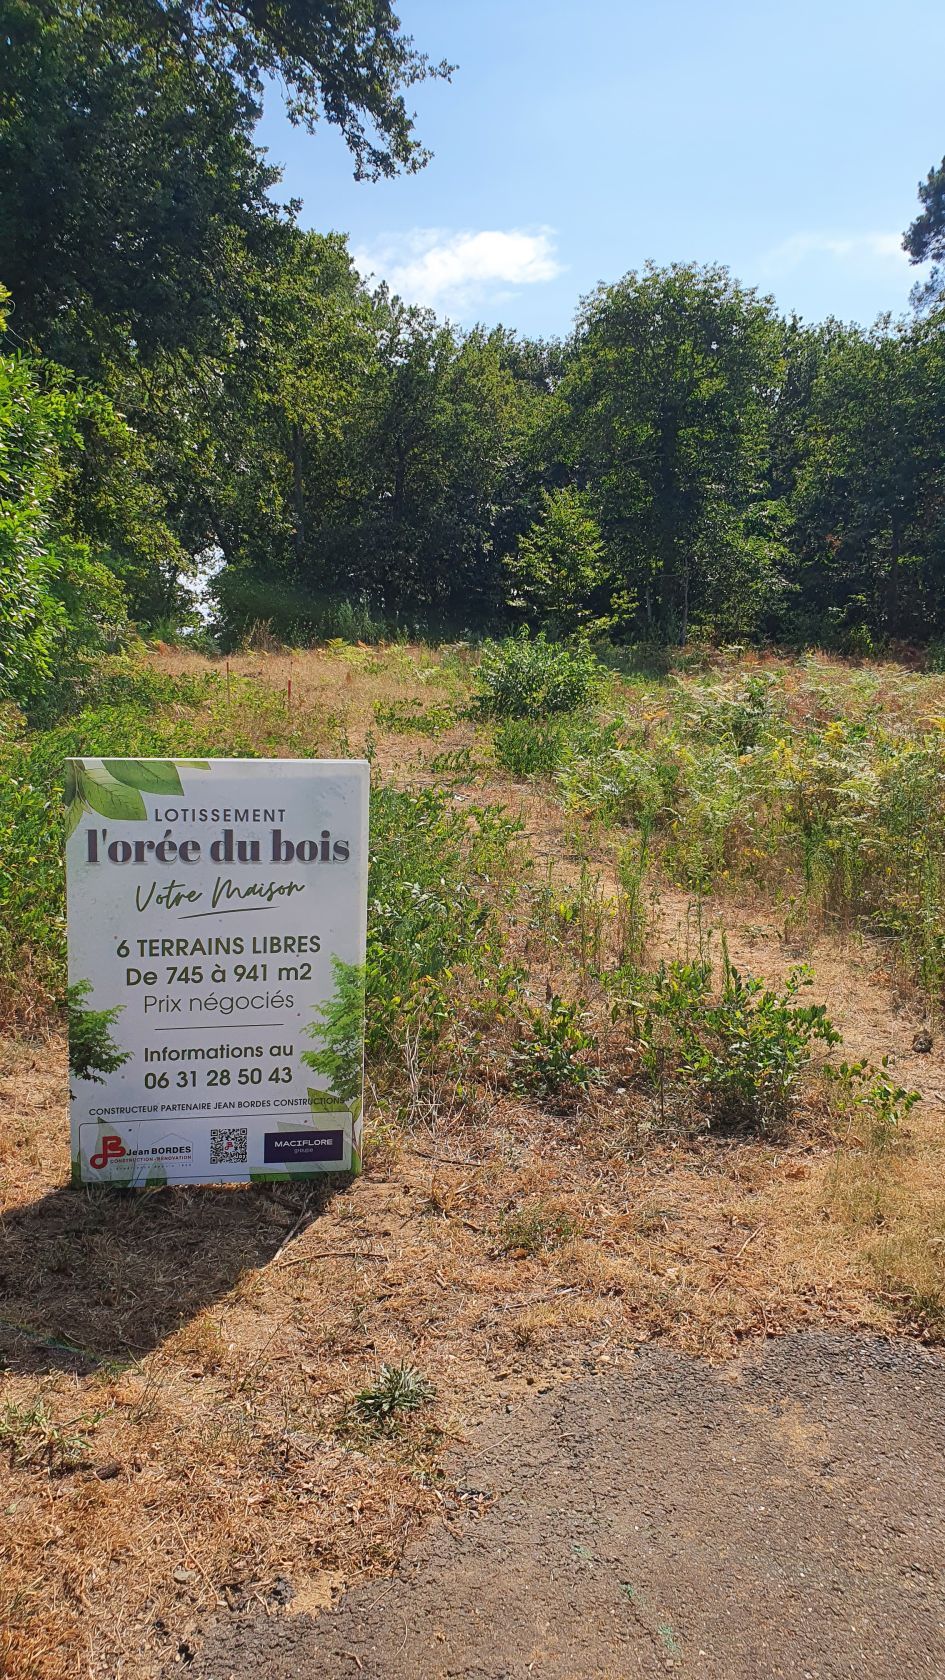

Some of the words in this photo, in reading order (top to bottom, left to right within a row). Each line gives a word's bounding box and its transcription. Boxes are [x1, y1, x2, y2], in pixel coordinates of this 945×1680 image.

[155, 808, 286, 823] LOTISSEMENT
[85, 828, 201, 865] l'orée
[210, 828, 262, 865] du
[269, 828, 350, 865] bois
[136, 880, 203, 912] Votre
[211, 876, 306, 909] Maison
[116, 939, 130, 958] 6
[137, 936, 245, 957] TERRAINS
[252, 935, 321, 954] LIBRES
[126, 967, 158, 986] De
[166, 965, 204, 984] 745
[211, 963, 226, 983] à
[233, 964, 268, 982] 941
[278, 962, 312, 981] m2
[144, 994, 181, 1014] Prix
[189, 989, 294, 1015] négociés
[144, 1044, 264, 1062] Informations
[269, 1045, 294, 1057] au
[144, 1071, 170, 1089] 06
[176, 1070, 197, 1088] 31
[206, 1069, 231, 1086] 28
[237, 1067, 262, 1085] 50
[268, 1066, 293, 1084] 43
[89, 1104, 158, 1116] CONSTRUCTEUR
[160, 1102, 212, 1112] PARTENAIRE
[213, 1101, 235, 1110] JEAN
[237, 1099, 271, 1109] BORDES
[273, 1097, 345, 1107] CONSTRUCTIONS
[126, 1148, 150, 1156] Jean
[151, 1146, 192, 1155] BORDES
[274, 1138, 334, 1148] MACIFLORE
